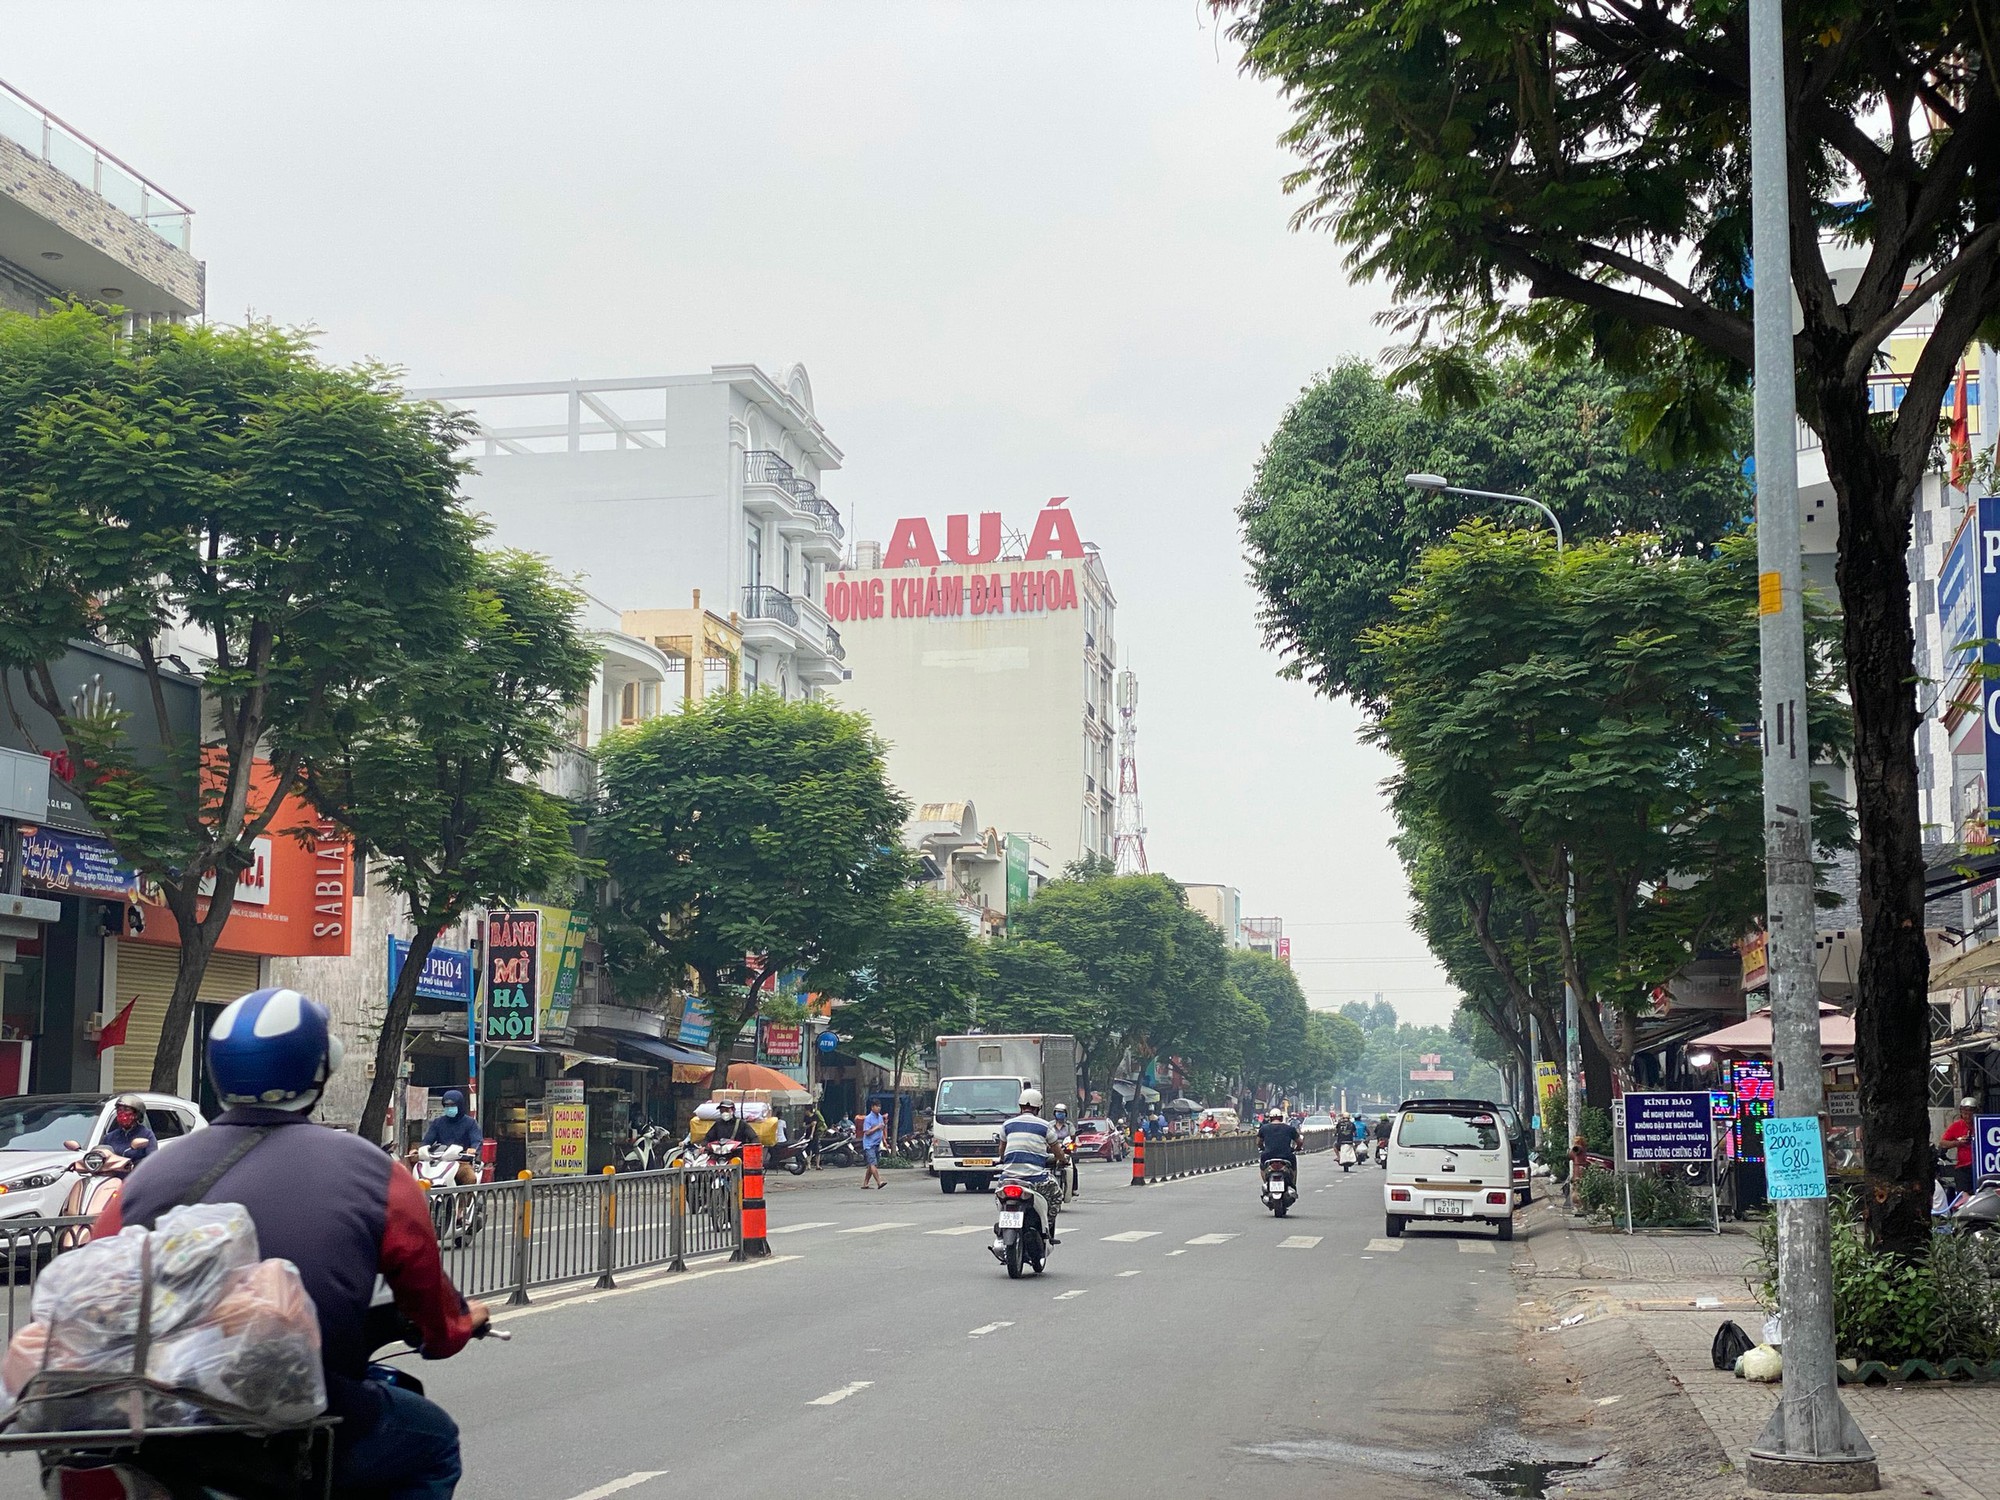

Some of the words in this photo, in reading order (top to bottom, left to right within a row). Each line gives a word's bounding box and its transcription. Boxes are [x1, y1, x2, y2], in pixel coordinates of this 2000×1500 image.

[891, 567, 963, 618] KHÁM
[971, 574, 1004, 615] ĐA
[1011, 569, 1078, 613] KHOA
[490, 913, 536, 947] BÁNH
[431, 957, 454, 977] PHỐ
[455, 963, 462, 979] 4
[493, 950, 530, 983] MÌ
[493, 984, 529, 1008] HÀ
[488, 1010, 533, 1040] NỘI
[1643, 1097, 1669, 1106] KÍNH
[1671, 1097, 1692, 1106] BÁO
[1676, 1109, 1694, 1118] KHÁCH
[1635, 1121, 1653, 1129] KHÔNG
[571, 1127, 584, 1139] HEO
[1661, 1133, 1675, 1141] NGÀY
[1676, 1132, 1687, 1140] CỦA
[1687, 1132, 1705, 1141] THÁNG
[561, 1140, 577, 1156] HẤP
[1769, 1135, 1797, 1150] 2000
[1632, 1146, 1653, 1158] PHÒNG
[1654, 1145, 1670, 1158] CÔNG
[1693, 1144, 1702, 1158] SỐ
[1702, 1148, 1707, 1158] 7
[1782, 1147, 1810, 1168] 680
[554, 1159, 567, 1168] NAM
